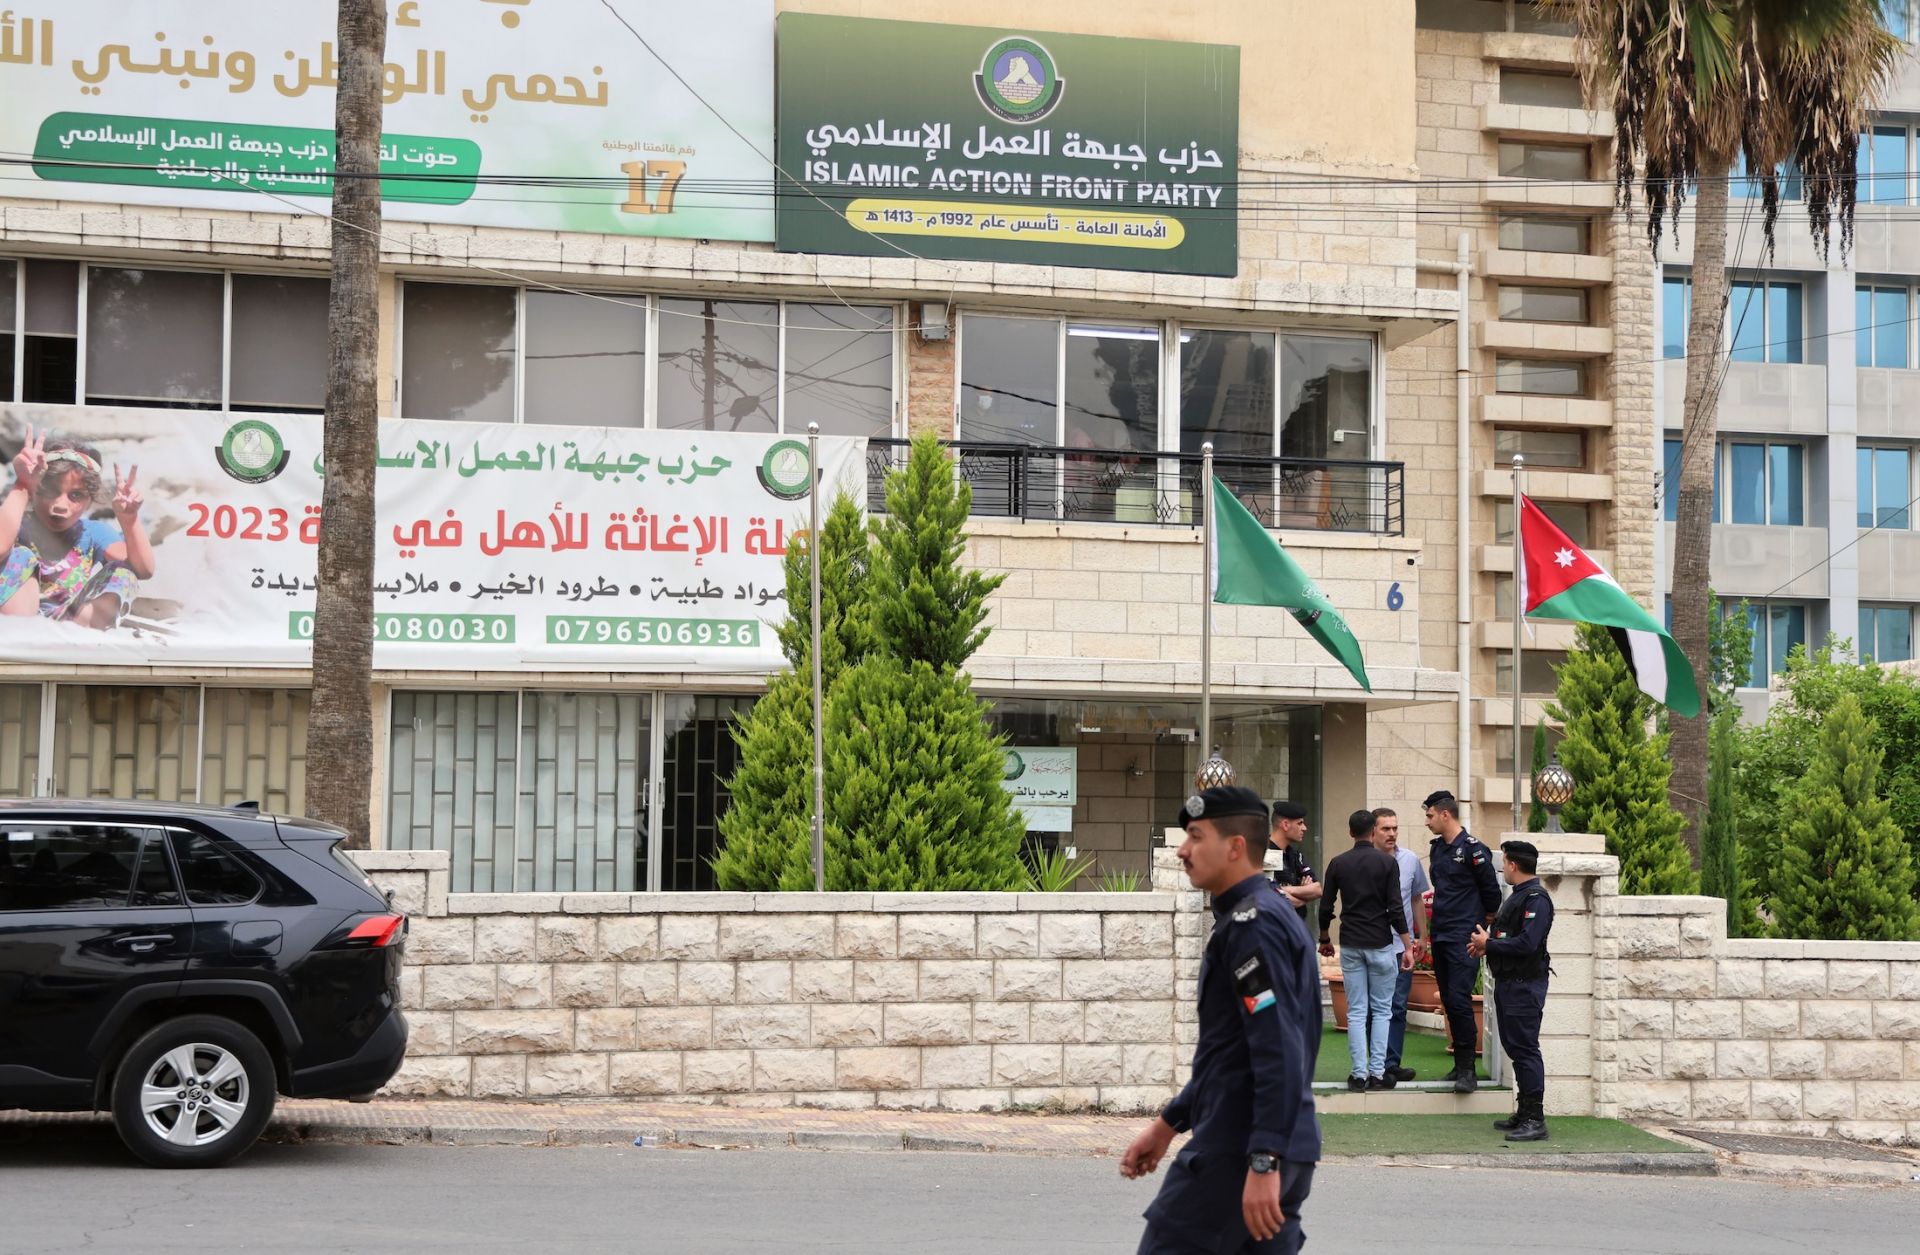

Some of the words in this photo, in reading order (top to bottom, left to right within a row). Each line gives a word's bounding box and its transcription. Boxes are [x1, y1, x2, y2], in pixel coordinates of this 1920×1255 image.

[71, 31, 256, 96] ونبني
[462, 65, 609, 124] نحمي
[58, 124, 157, 150] الإسلامي
[160, 129, 223, 152] العمل
[228, 134, 283, 158] جبهة
[288, 139, 328, 161] حزب
[805, 118, 951, 163] الإسلامي
[962, 124, 1050, 161] العمل
[1061, 131, 1148, 171] جبهة
[1157, 140, 1224, 175] حزب
[620, 159, 688, 215] 17
[804, 159, 920, 189] ISLAMIC
[927, 167, 1032, 196] ACTION
[1040, 173, 1129, 202] FRONT
[1136, 179, 1224, 208] PARTY
[883, 208, 914, 223] 1413
[939, 211, 974, 226] 1992
[979, 214, 1006, 231] عام
[1010, 213, 1059, 232] تأسس
[1076, 220, 1118, 236] العامة
[1123, 219, 1167, 239] الأمانة
[457, 439, 557, 478] العمل
[563, 440, 652, 484] جبهة
[656, 444, 733, 486] حزب
[185, 502, 290, 542] 2023
[392, 508, 464, 559] في
[479, 500, 590, 557] للأهل
[604, 506, 729, 567] الإغاثة
[467, 572, 545, 600] الخير
[555, 575, 620, 603] طرود
[650, 576, 724, 606] طبية
[1386, 581, 1405, 612] 6
[554, 618, 754, 646] 0796506936
